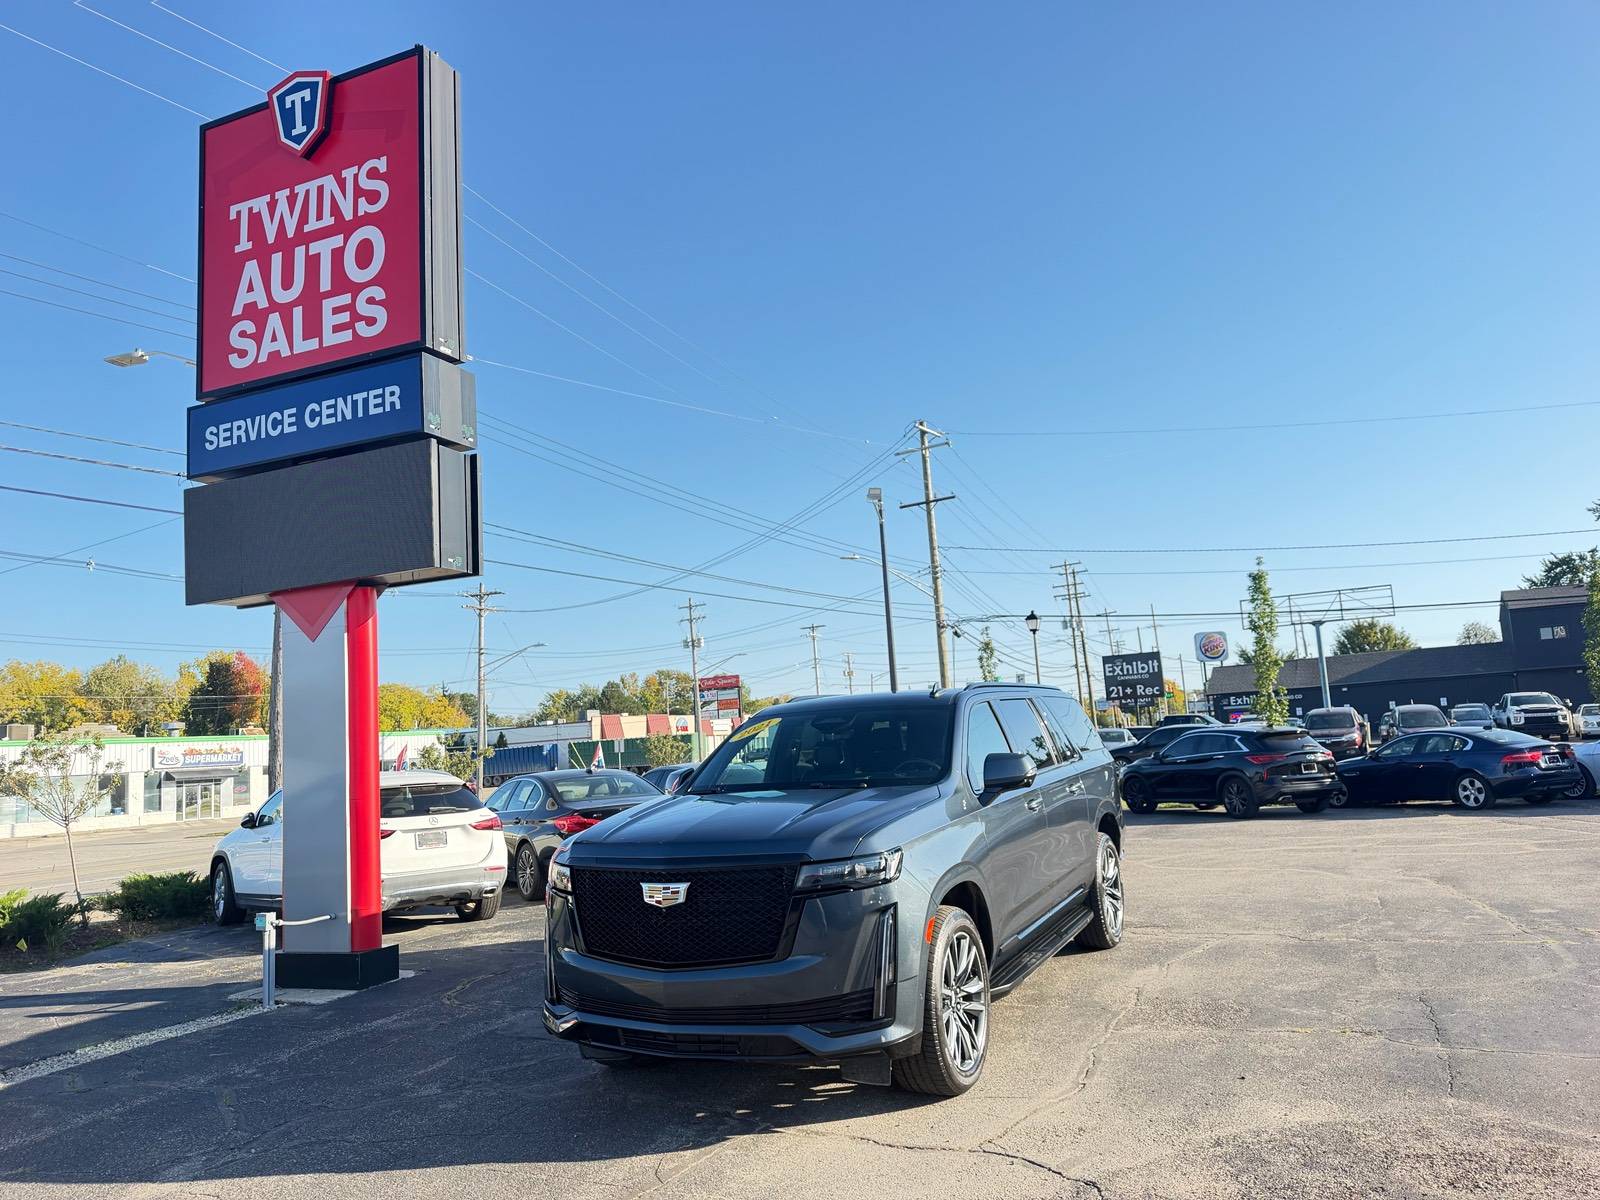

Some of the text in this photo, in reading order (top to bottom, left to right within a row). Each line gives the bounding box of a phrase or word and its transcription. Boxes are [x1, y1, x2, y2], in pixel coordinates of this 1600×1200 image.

[285, 88, 311, 136] T
[229, 156, 390, 253] TWINS
[231, 225, 386, 317] AUTO
[227, 286, 388, 369] SALES
[204, 385, 401, 450] SERVICE CENTER
[1203, 641, 1224, 654] KING
[1109, 685, 1160, 697] 21+ Rec
[185, 753, 241, 763] SUPERMARKET
